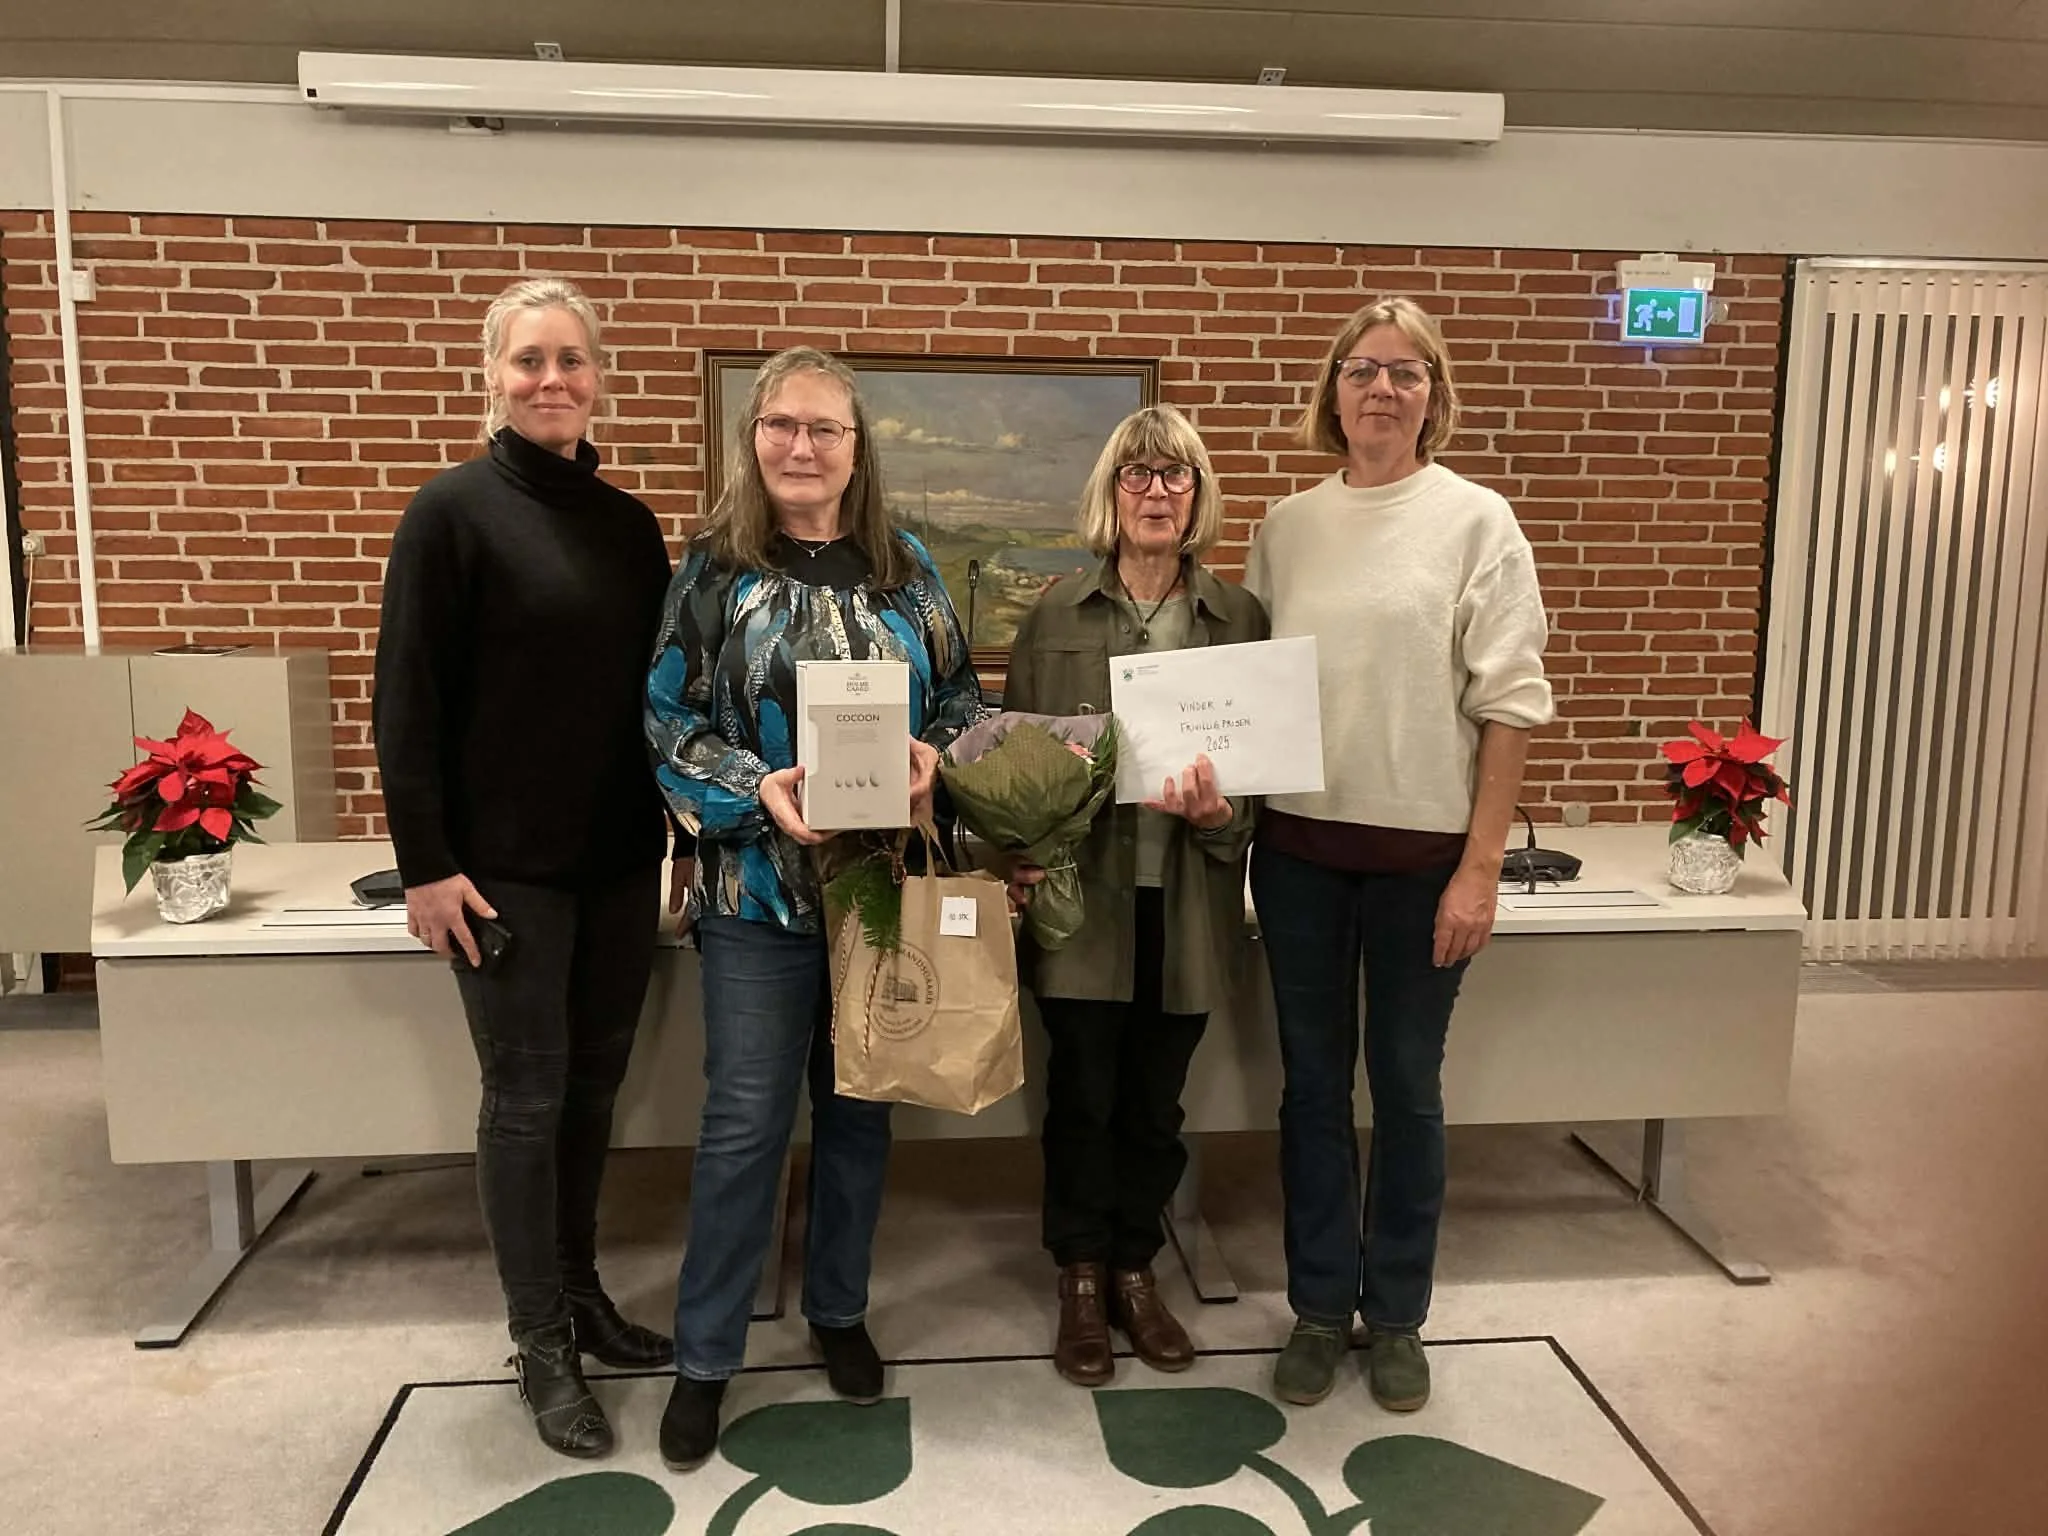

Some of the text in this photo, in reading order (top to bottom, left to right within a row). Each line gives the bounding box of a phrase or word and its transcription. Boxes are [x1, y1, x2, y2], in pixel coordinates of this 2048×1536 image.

[1180, 700, 1216, 713] VINDER
[836, 713, 880, 722] COCOON
[1206, 735, 1231, 752] 2025
